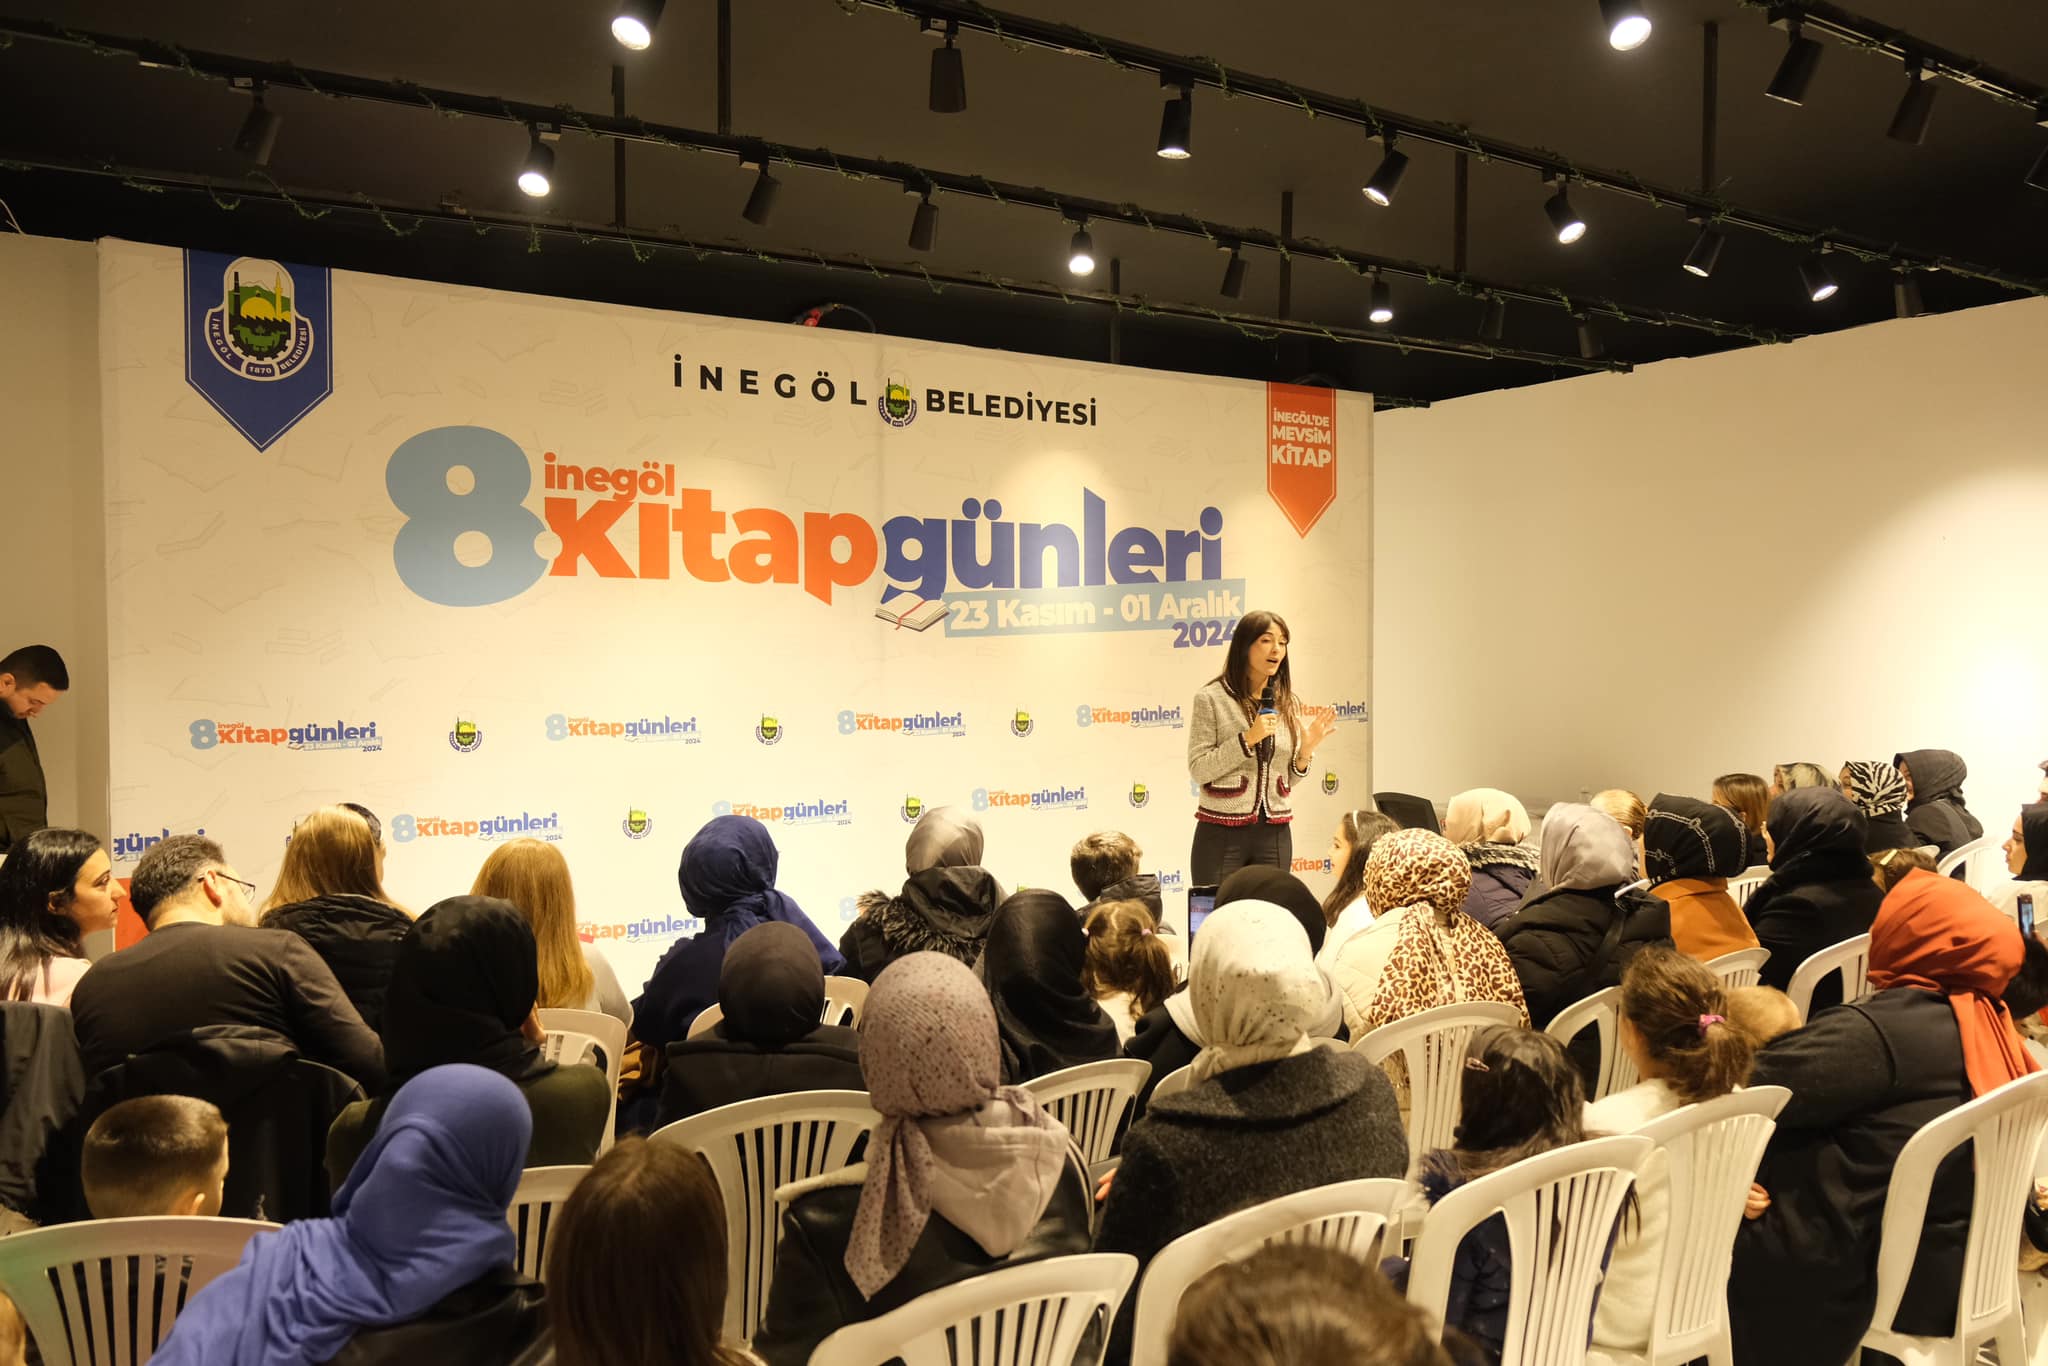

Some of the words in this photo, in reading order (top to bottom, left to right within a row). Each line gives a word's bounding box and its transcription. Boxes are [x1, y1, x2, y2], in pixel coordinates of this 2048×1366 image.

[248, 365, 272, 374] 1870
[673, 354, 867, 406] İNEGÖL
[926, 388, 1097, 426] BELEDİYESİ
[1272, 424, 1331, 445] MEVSİM
[1271, 443, 1332, 468] KİTAP
[544, 452, 675, 500] inegöl
[385, 425, 549, 607] 8
[948, 600, 989, 630] 23
[997, 598, 1096, 629] Kasım
[1120, 594, 1151, 622] 01
[1158, 589, 1241, 622] Aralık
[545, 713, 568, 741] 8
[837, 710, 856, 735] 8
[1076, 704, 1092, 727] 8
[190, 719, 218, 750] 8
[362, 744, 382, 752] 2024
[972, 788, 988, 811] 8
[391, 814, 417, 842] 8
